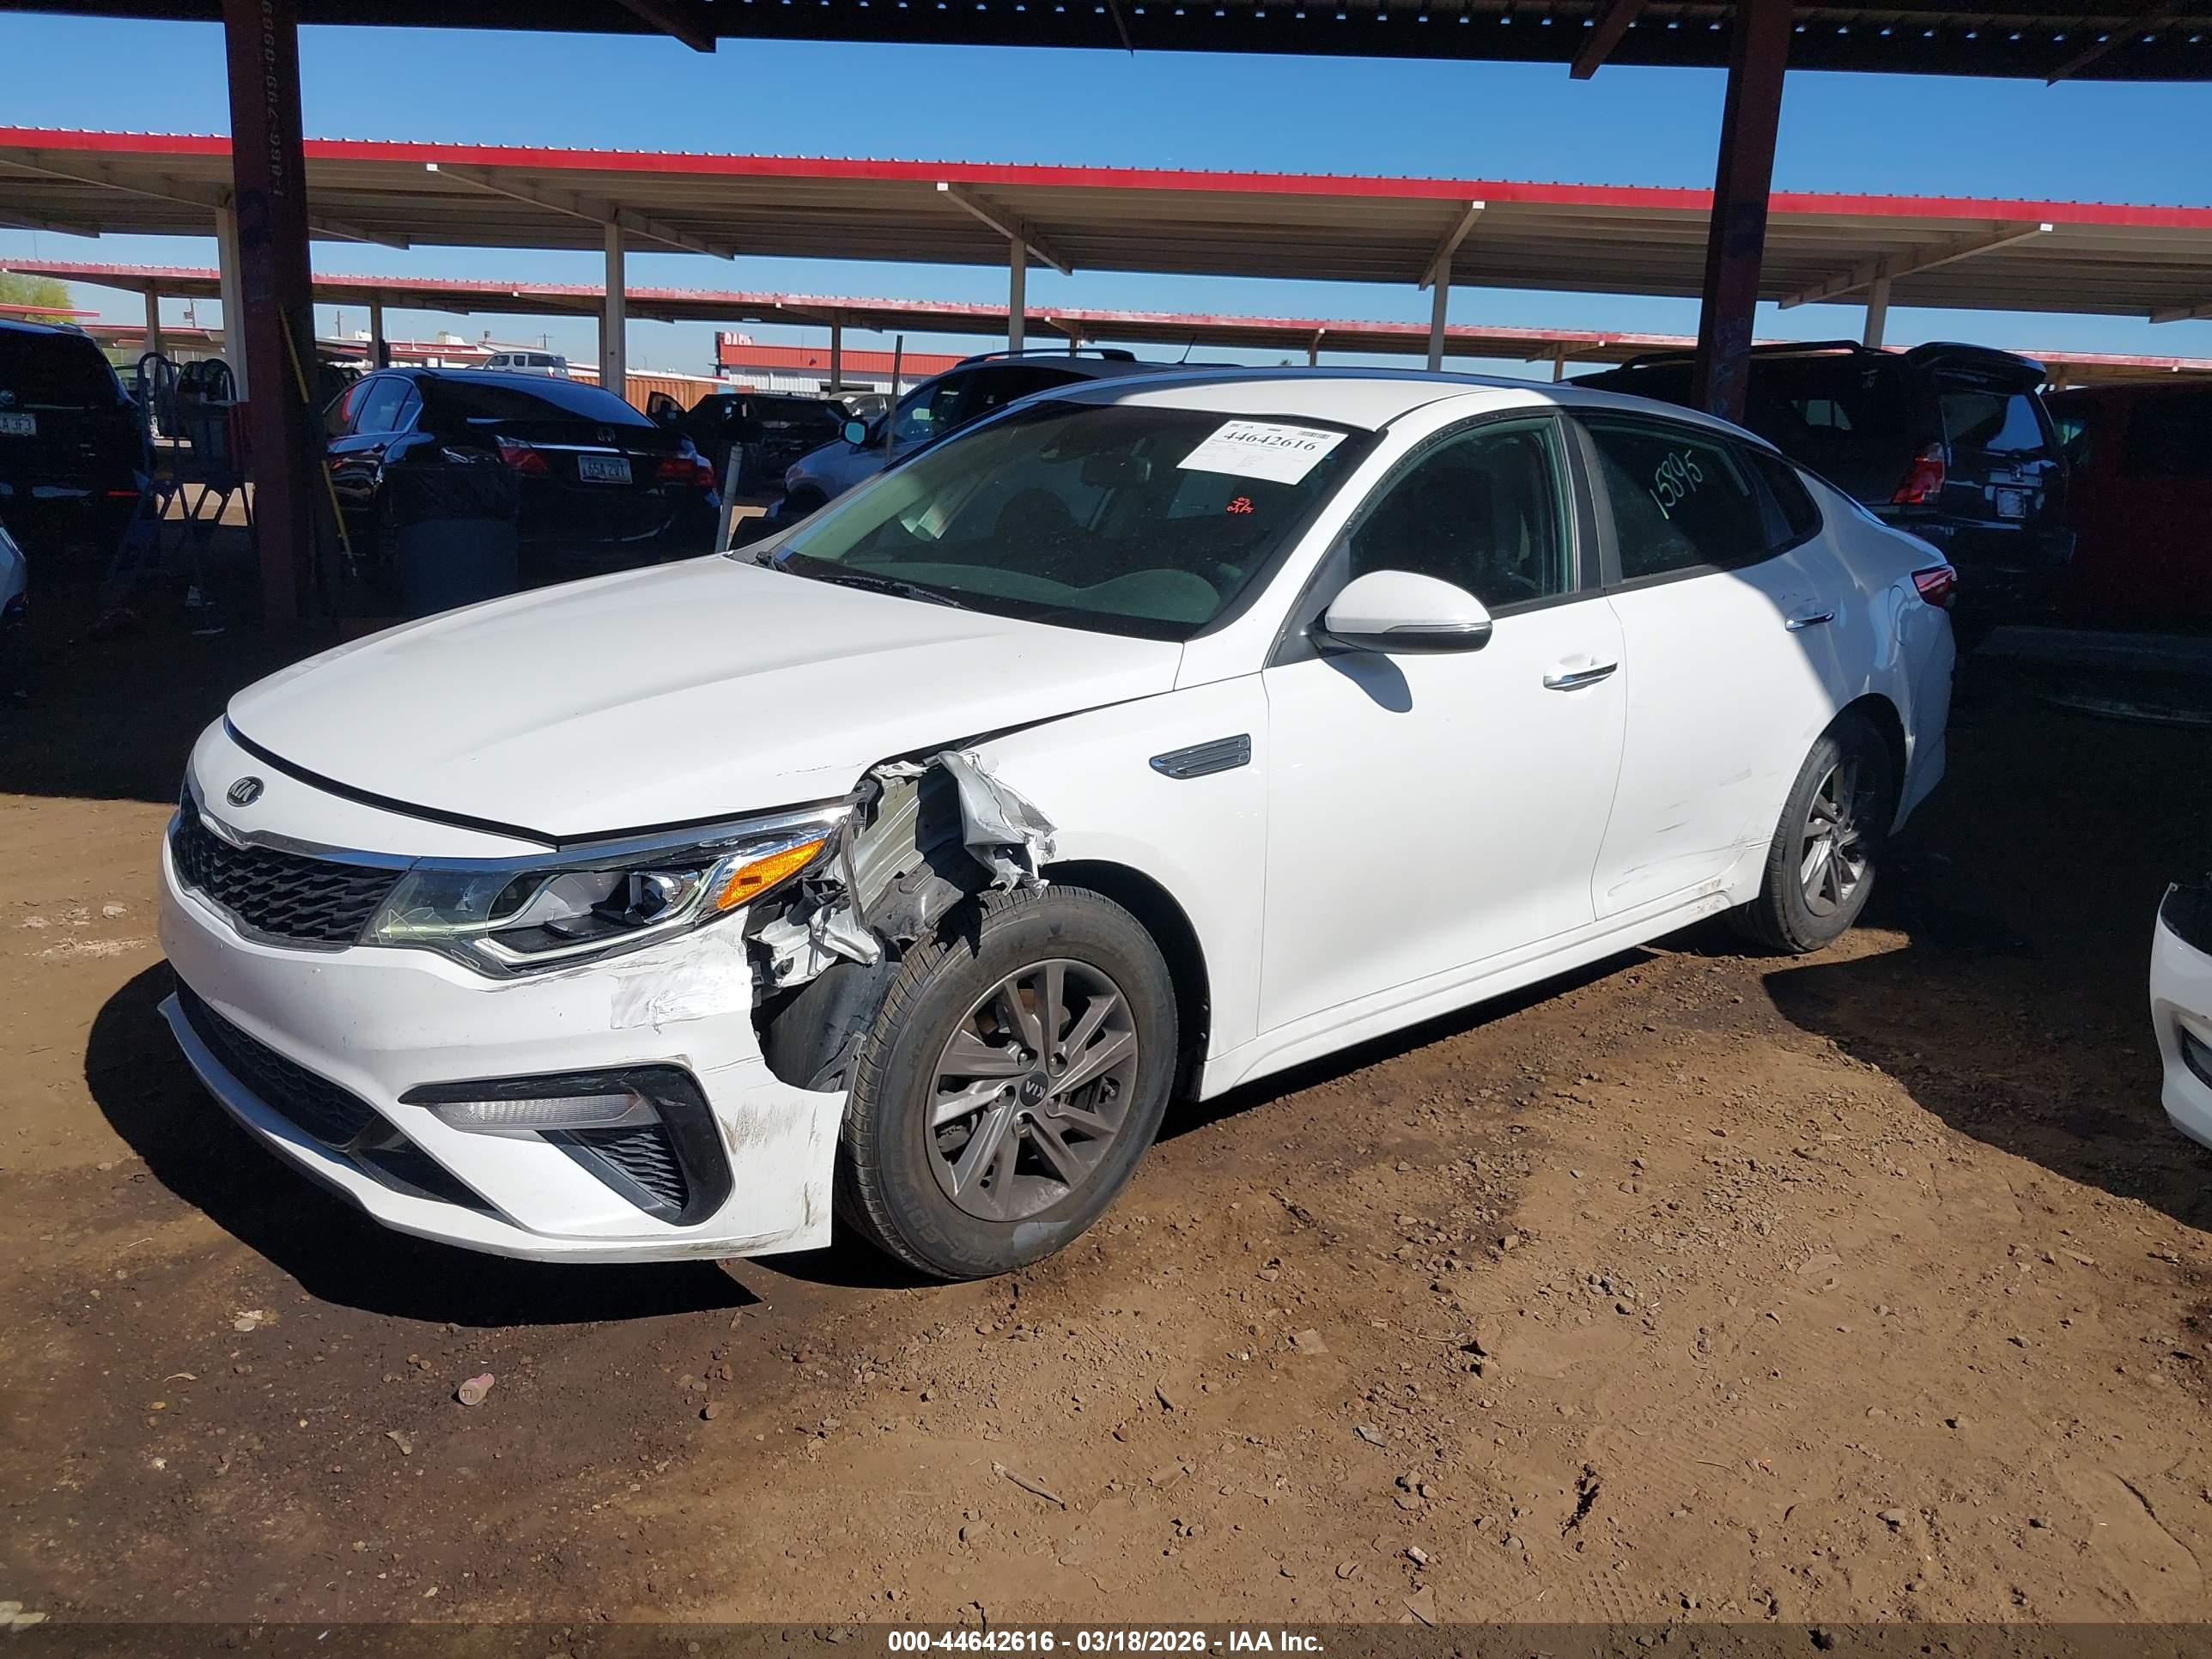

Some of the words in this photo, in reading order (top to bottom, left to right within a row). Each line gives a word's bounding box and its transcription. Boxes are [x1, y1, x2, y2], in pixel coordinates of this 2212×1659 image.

[1224, 431, 1319, 452] 44642616
[1650, 449, 1702, 520] 15895
[229, 779, 258, 802] KIA
[1025, 1080, 1046, 1099] KIA
